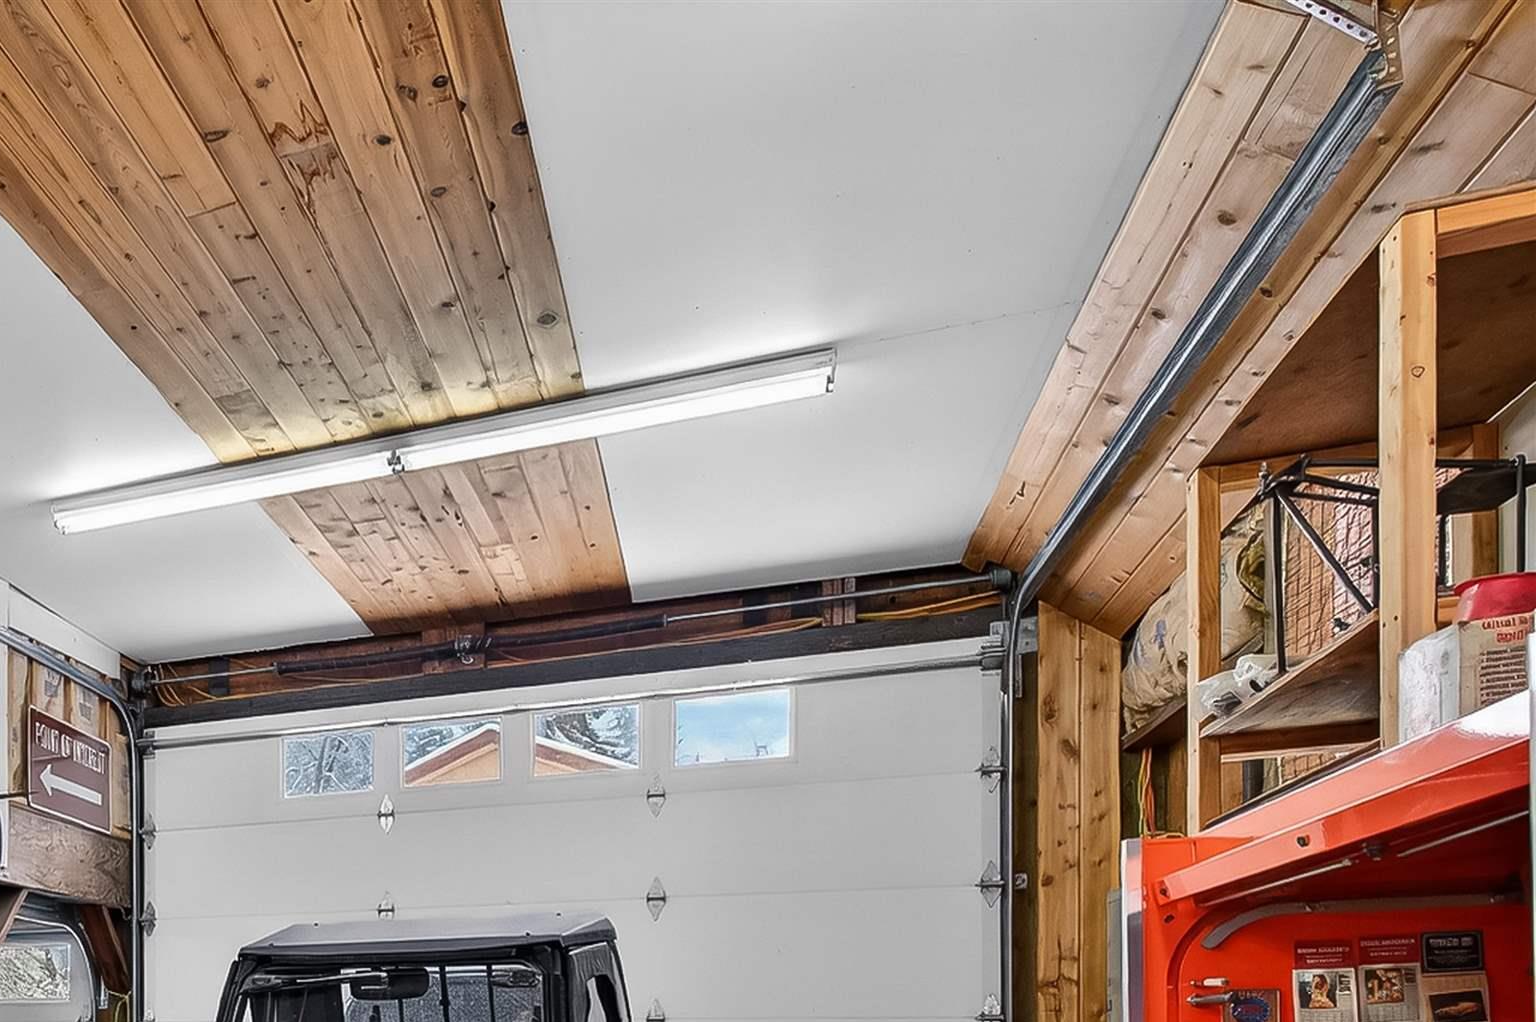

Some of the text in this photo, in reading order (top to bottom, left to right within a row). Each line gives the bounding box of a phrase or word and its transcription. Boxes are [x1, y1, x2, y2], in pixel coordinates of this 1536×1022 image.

[35, 721, 105, 775] POINT OF INTEREST
